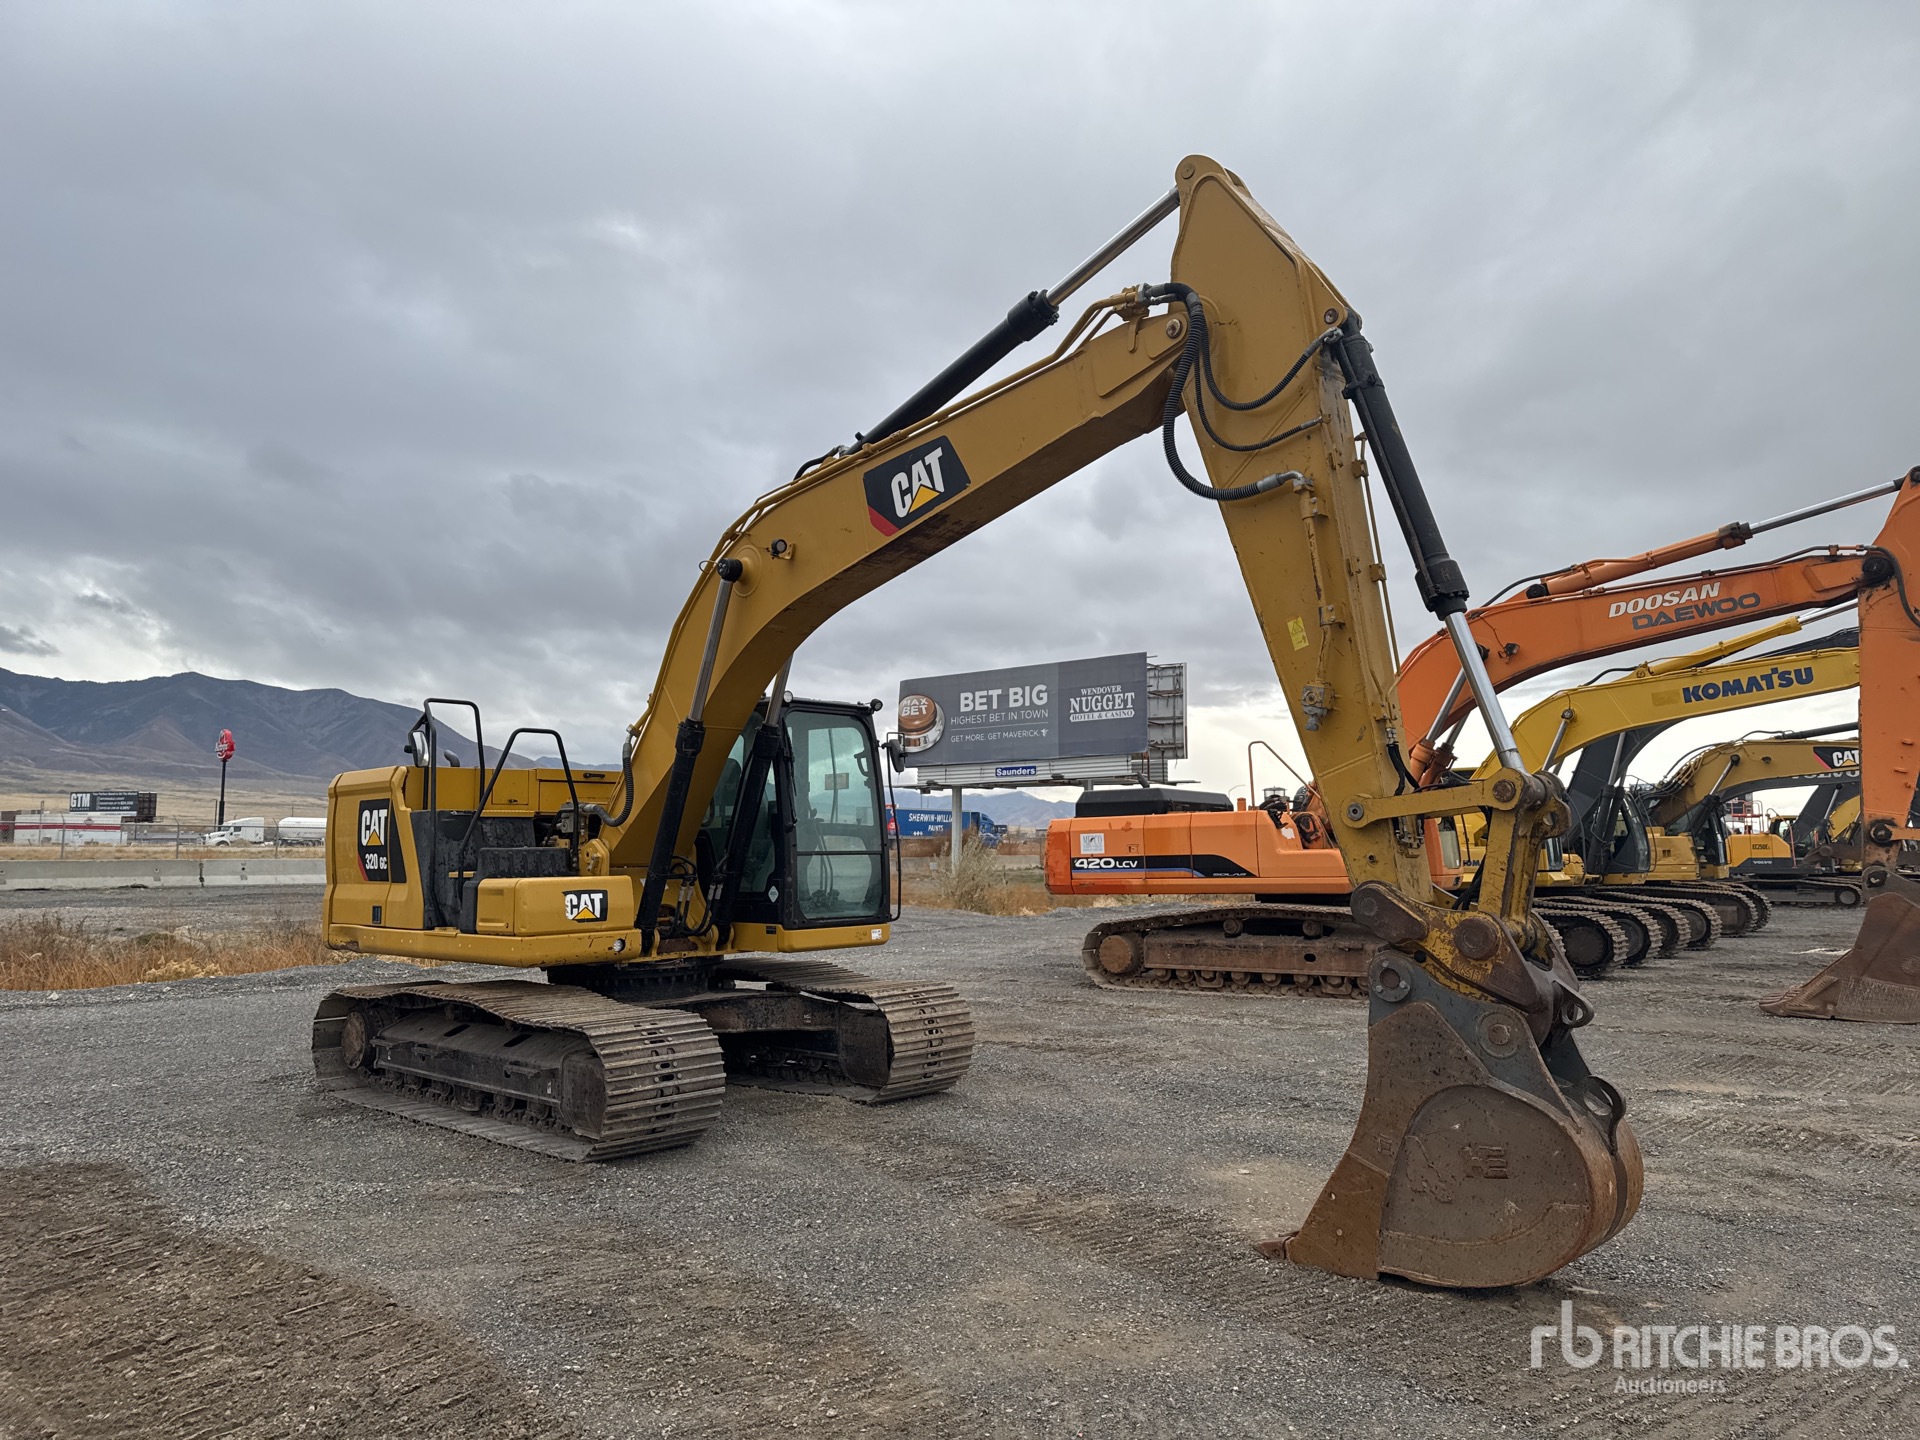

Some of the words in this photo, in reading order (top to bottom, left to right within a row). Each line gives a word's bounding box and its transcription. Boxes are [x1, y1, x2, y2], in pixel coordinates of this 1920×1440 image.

[891, 447, 944, 517] CAT
[1608, 582, 1720, 618] DOOSAN
[1632, 592, 1760, 630] DAEWOO
[1080, 685, 1122, 695] WENDOVER
[1682, 666, 1814, 703] KOMATSU
[901, 697, 928, 706] MAX
[960, 689, 1002, 712] BET
[1009, 684, 1048, 708] BIG
[1069, 692, 1135, 713] NUGGET
[901, 704, 928, 717] BET
[950, 714, 986, 725] HIGHEST
[989, 712, 1005, 722] BET
[1008, 711, 1018, 721] IN
[1021, 709, 1048, 719] TOWN
[1072, 713, 1097, 721] HOTEL
[1104, 710, 1133, 719] CASINO
[951, 734, 963, 743] GET
[965, 733, 986, 741] MORE.
[988, 732, 1001, 740] GET
[1832, 749, 1859, 767] CAT
[996, 767, 1035, 776] Saunders
[70, 793, 90, 807] GTM
[908, 813, 953, 822] SHERWIN-WILLI
[361, 809, 387, 846] CAT
[928, 824, 944, 832] PAINTS
[365, 853, 378, 869] 320
[379, 856, 388, 869] GC
[565, 893, 603, 920] CAT
